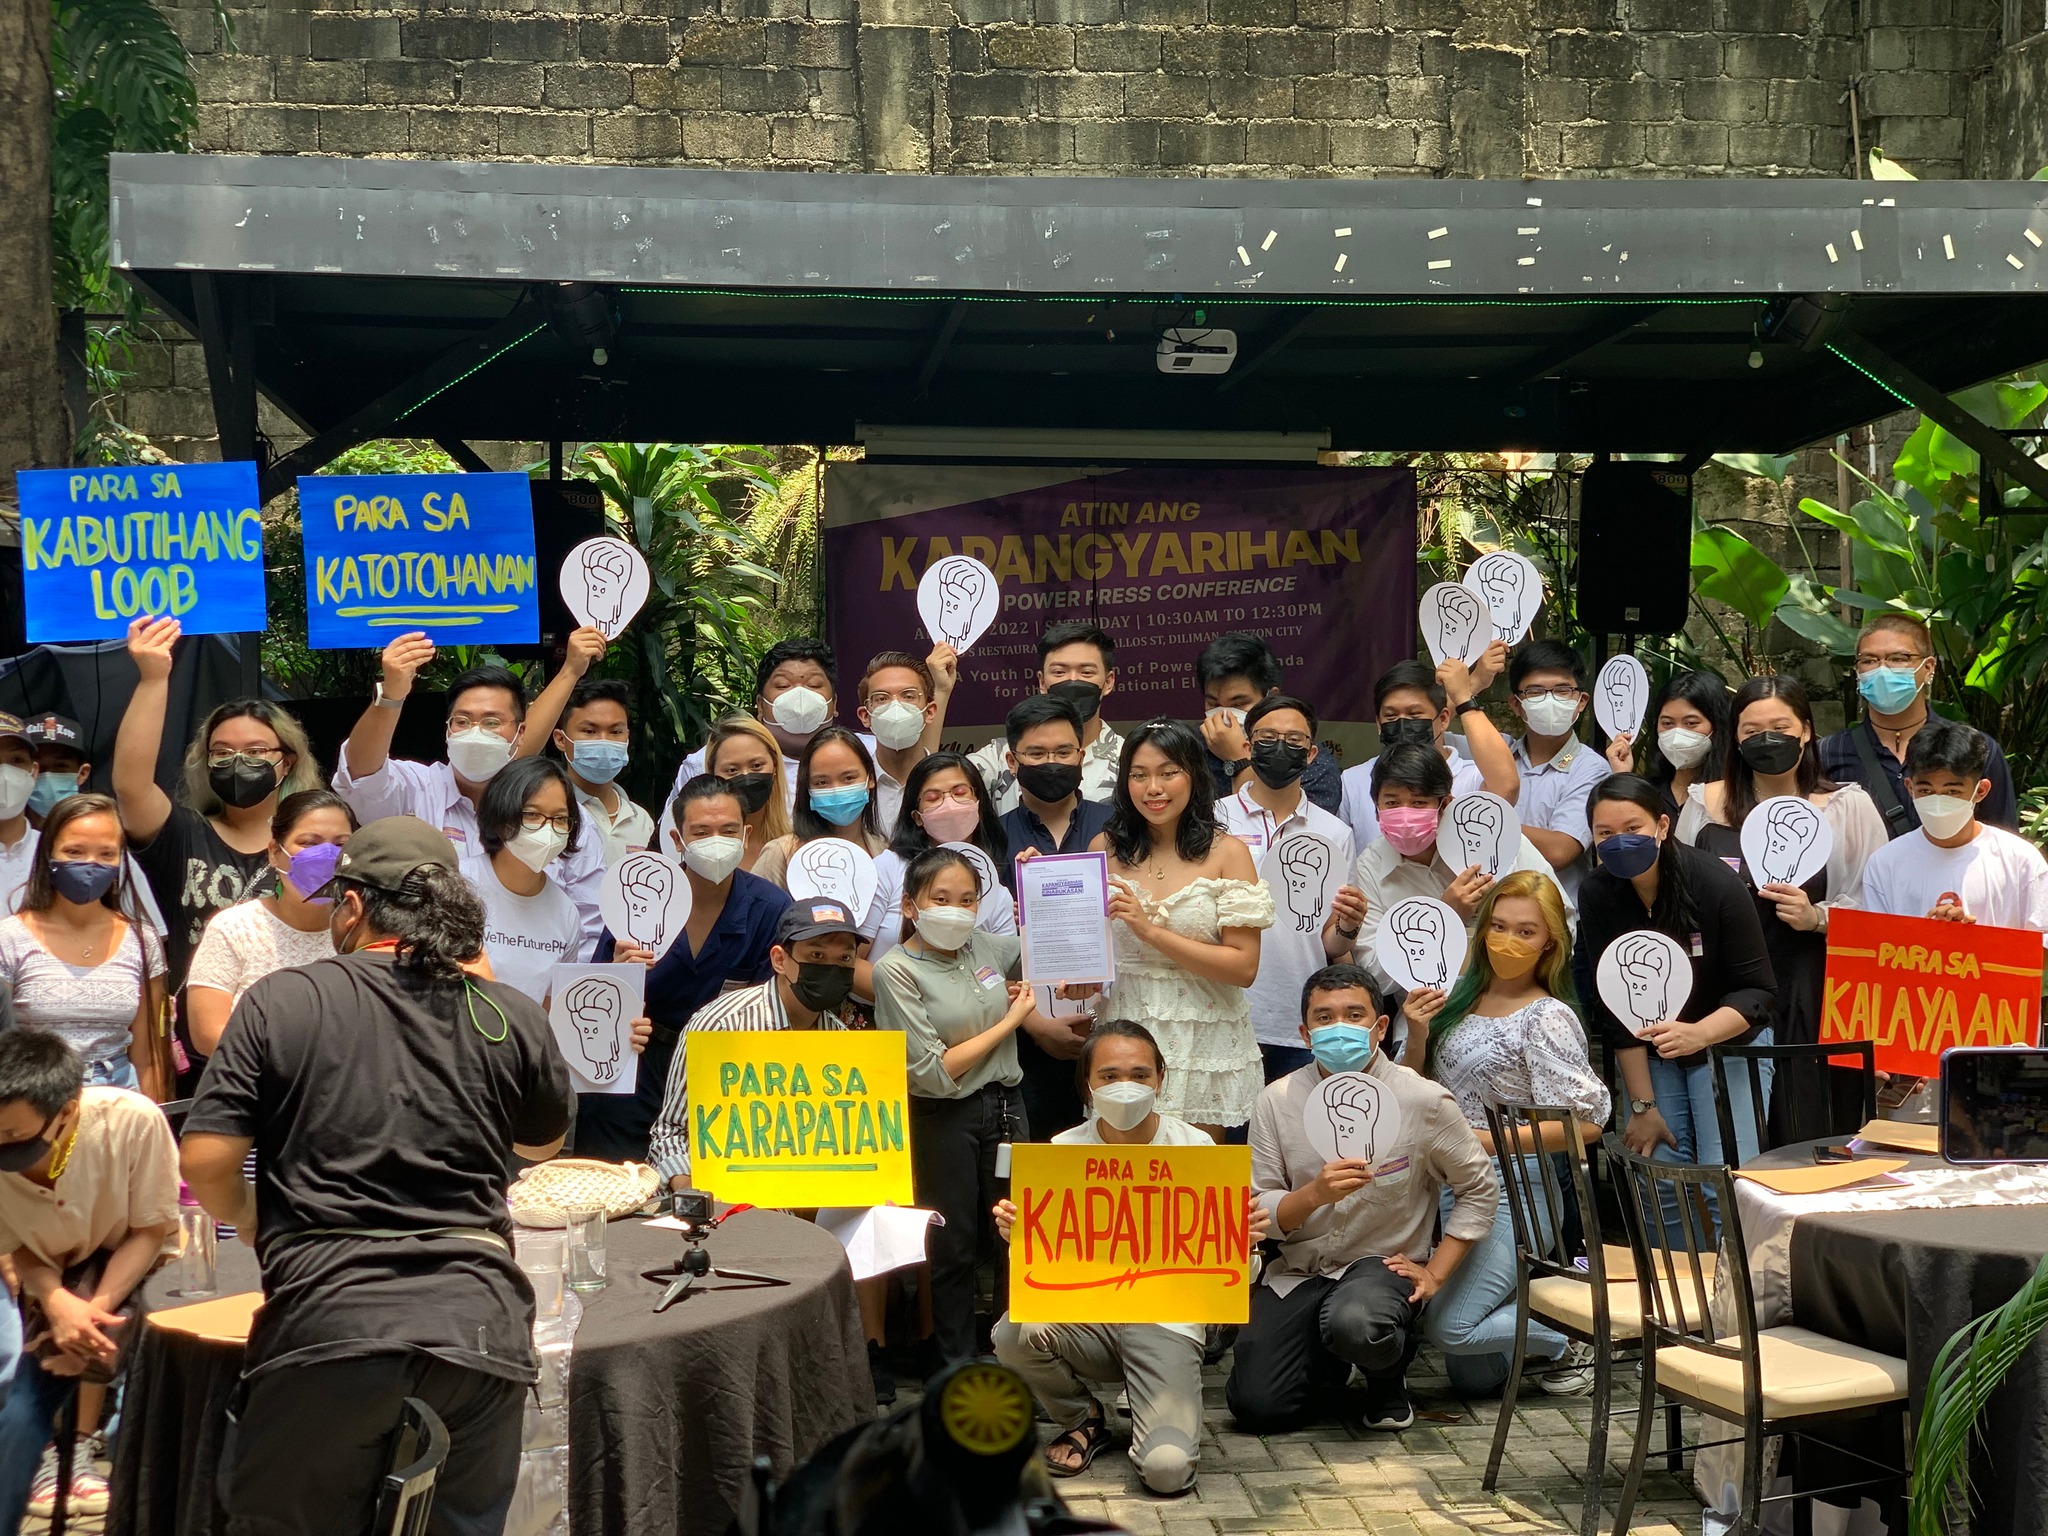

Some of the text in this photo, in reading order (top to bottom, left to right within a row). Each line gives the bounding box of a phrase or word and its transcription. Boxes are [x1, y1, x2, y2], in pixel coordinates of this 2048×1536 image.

[70, 472, 182, 502] PARA SA
[334, 493, 470, 532] PARA SA
[1061, 501, 1201, 527] ATIN ANG
[24, 508, 262, 570] KABUTIHANG
[90, 564, 198, 620] LOOB
[316, 552, 535, 605] KATOTOHANAN
[1004, 576, 1297, 612] POWER PRESS CONFERENCE
[989, 621, 1029, 636] 2022
[1147, 609, 1218, 627] 10:30AM
[1223, 607, 1245, 622] TO
[1252, 603, 1322, 620] 12:30PM
[1276, 625, 1303, 637] CITY
[970, 667, 1018, 682] Youth
[1127, 661, 1143, 675] of
[1150, 661, 1196, 675] Powe
[995, 685, 1018, 699] for
[1113, 678, 1175, 692] ational
[1878, 943, 1980, 979] PARA SA
[1822, 977, 2028, 1055] KALAYAAN
[720, 1063, 867, 1096] PARA SA
[696, 1100, 903, 1158] KARAPATAN
[1086, 1158, 1173, 1181] PARA SA
[1023, 1185, 1250, 1265] KAPATIRAN
